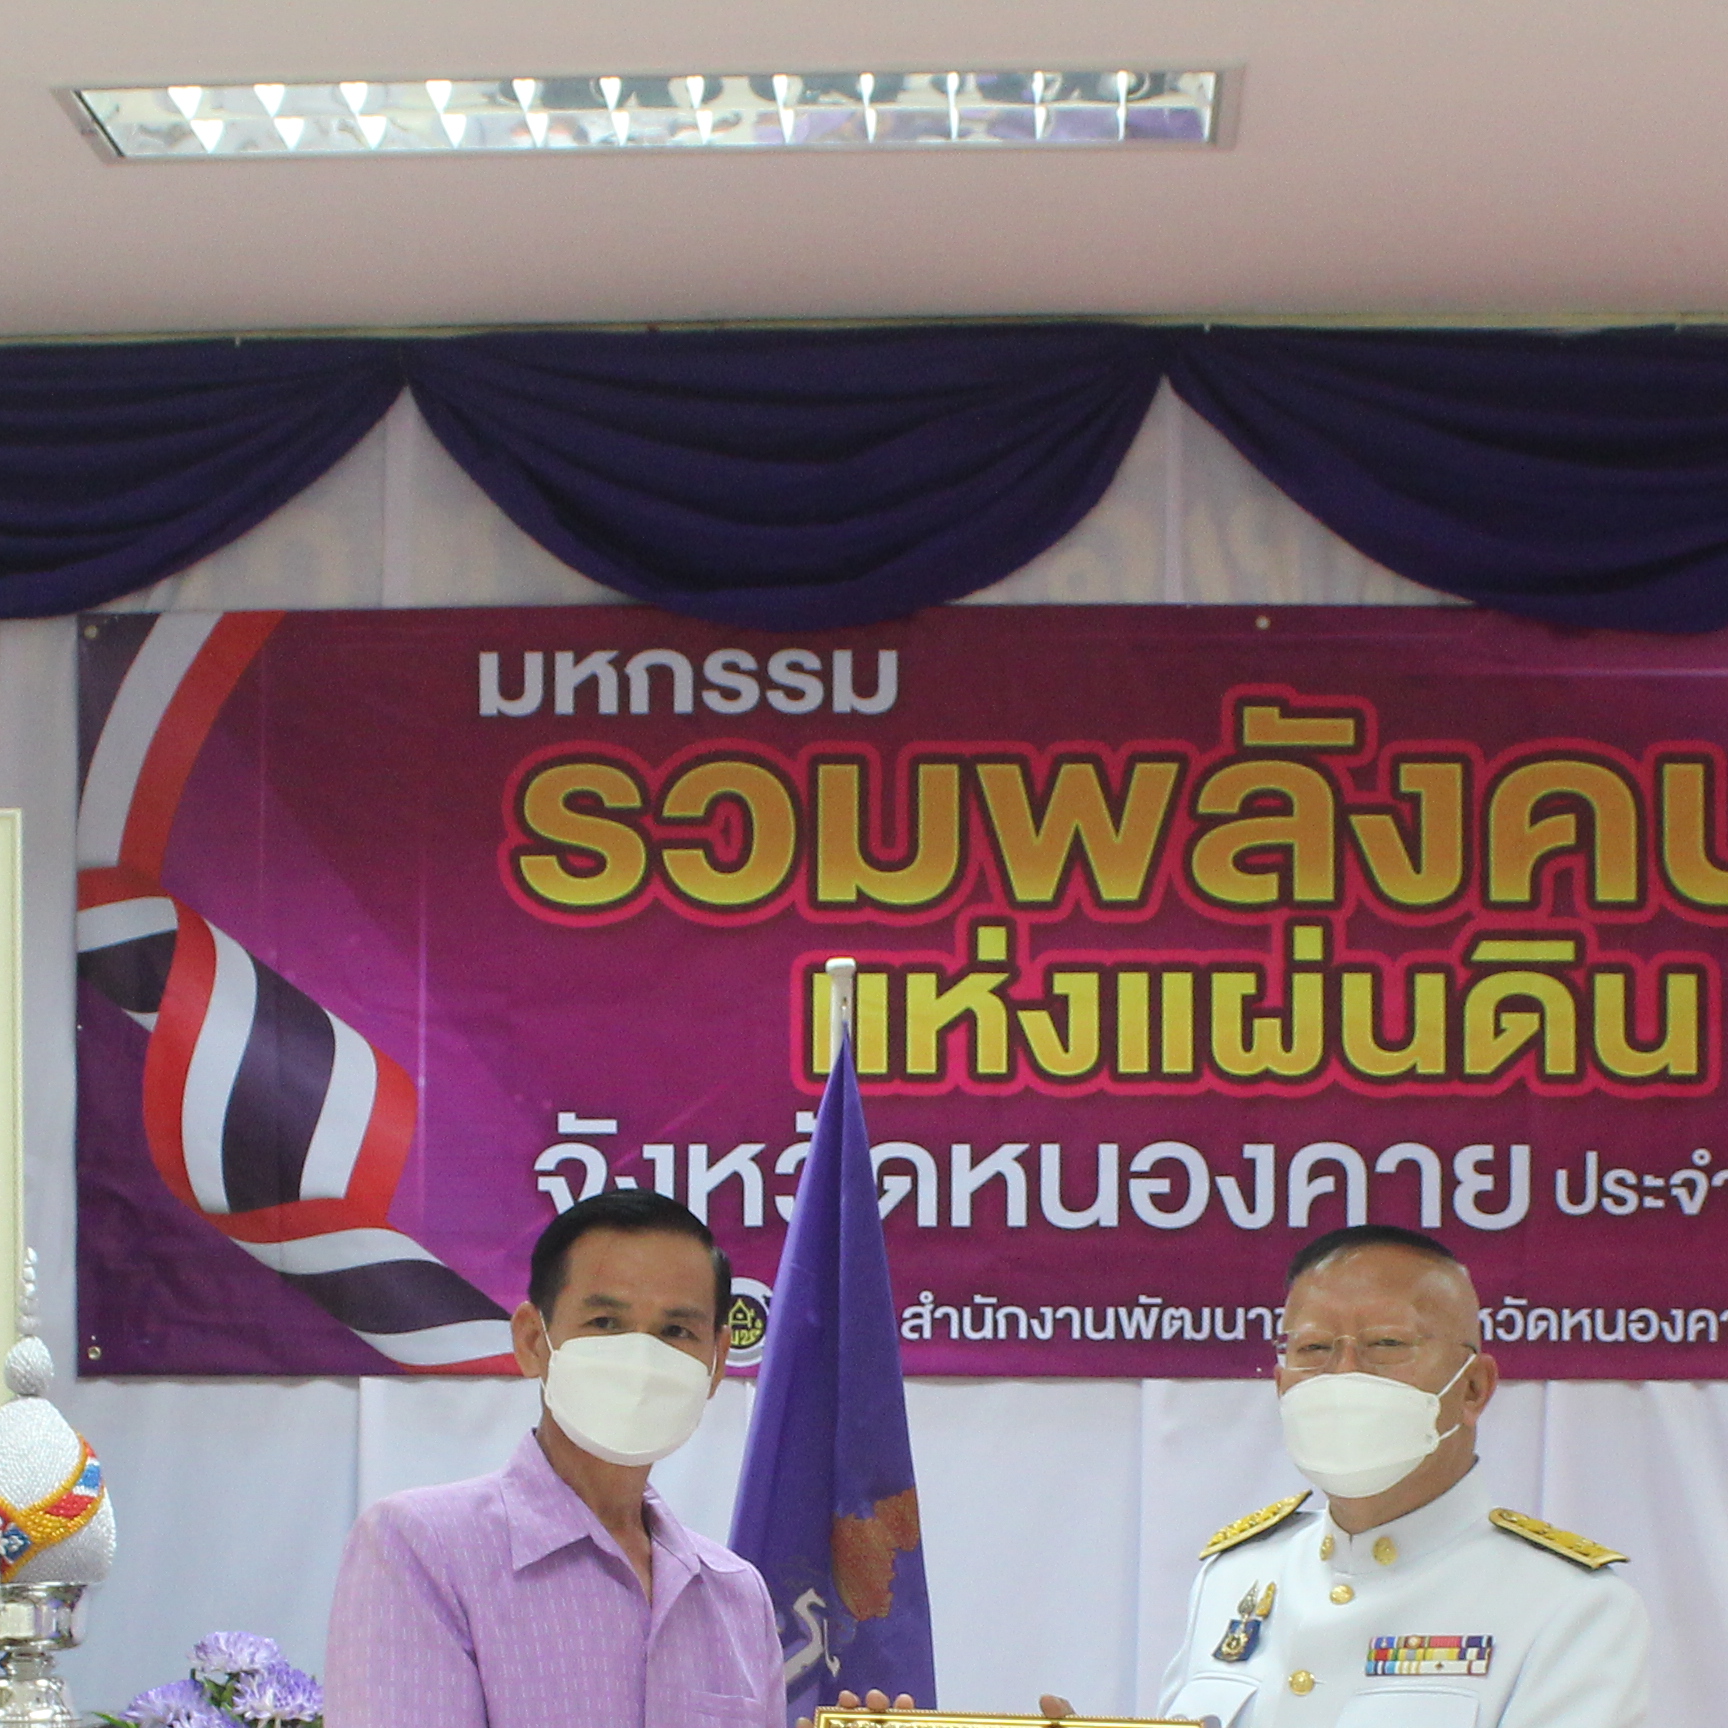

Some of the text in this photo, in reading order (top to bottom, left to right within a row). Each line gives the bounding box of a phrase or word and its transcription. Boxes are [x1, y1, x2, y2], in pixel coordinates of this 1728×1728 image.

[478, 648, 900, 717] มหกรรม
[811, 925, 1700, 1080] แห่งแผ่นดิน
